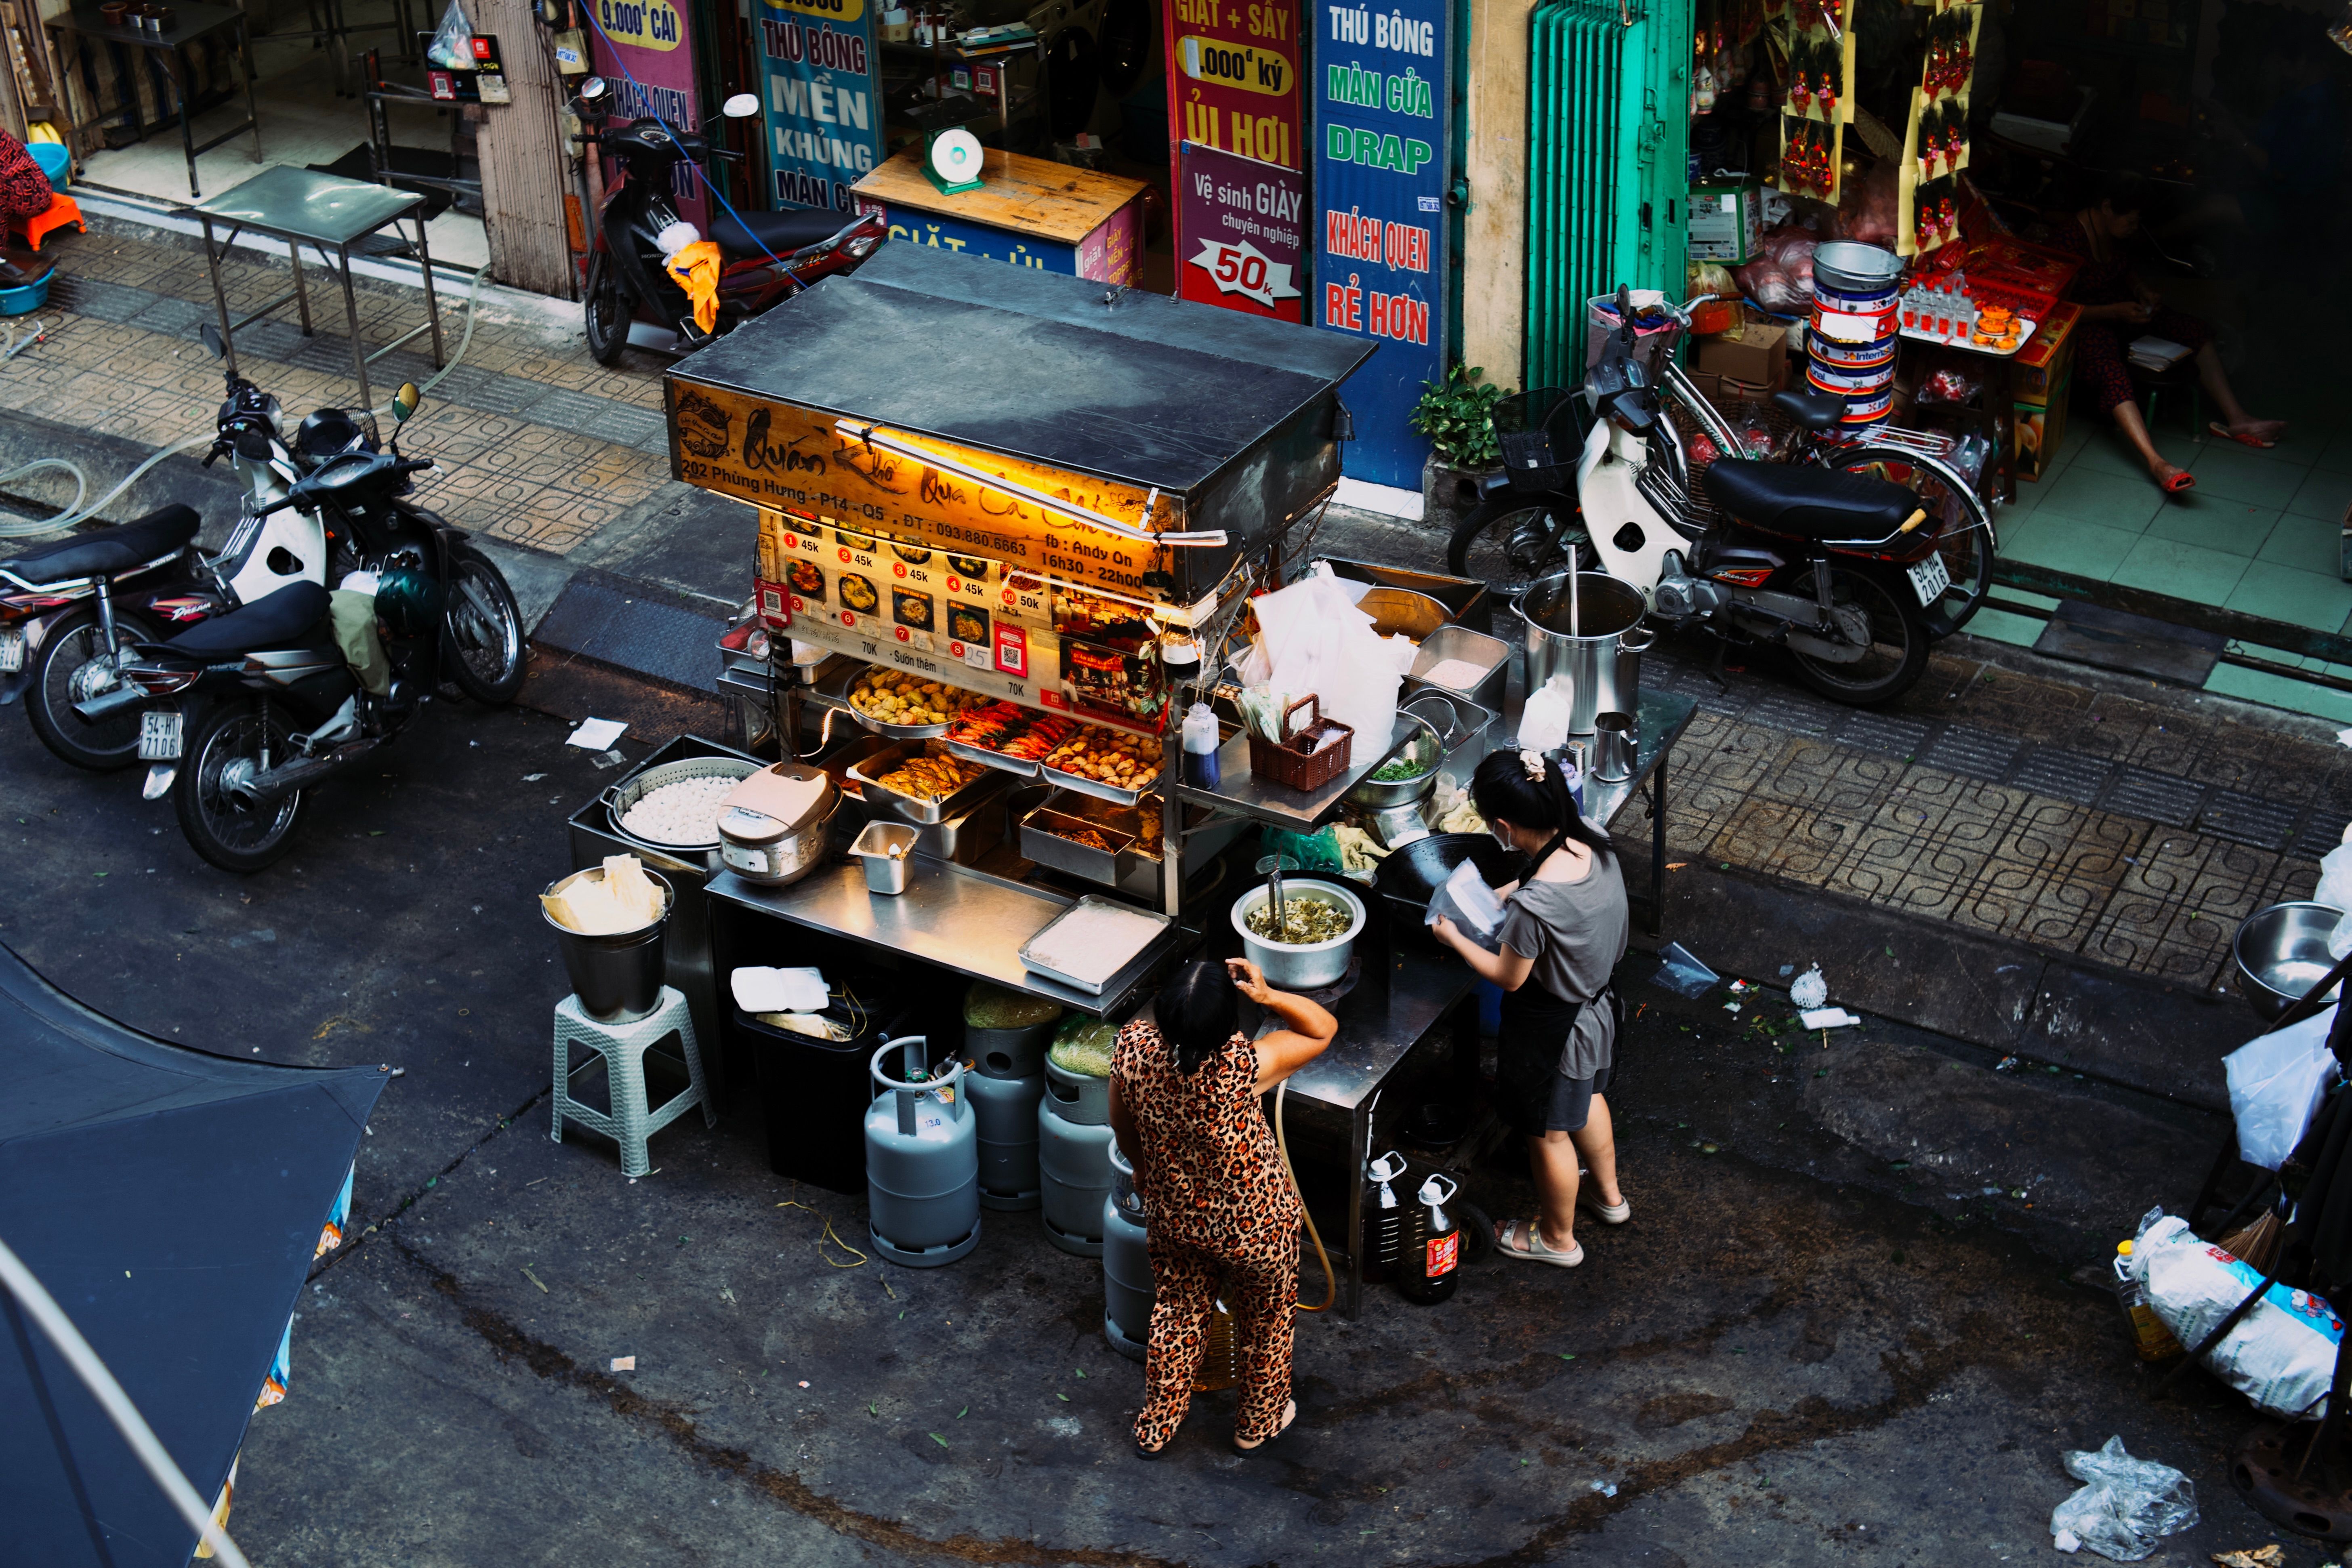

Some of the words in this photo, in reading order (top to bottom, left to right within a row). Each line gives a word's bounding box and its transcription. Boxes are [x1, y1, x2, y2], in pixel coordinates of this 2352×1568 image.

[650, 3, 677, 42] CÁI
[1329, 3, 1369, 45] THÚ
[1375, 9, 1433, 57] BÔNG
[760, 16, 804, 63] THÚ
[806, 22, 868, 76] BÔNG
[1258, 57, 1283, 92] ký
[1328, 61, 1381, 109] MÀN
[1386, 66, 1433, 119] CỬA
[770, 72, 868, 130] MỀN
[1185, 88, 1220, 149] ỦI
[1232, 111, 1290, 166] HƠI
[775, 127, 872, 173] KHỦNG
[1327, 123, 1432, 175] DRAP
[775, 167, 829, 209] MÀN
[1194, 172, 1213, 205] Vệ
[1217, 182, 1252, 211] sinh
[1256, 179, 1302, 223] GIÀY
[1222, 212, 1260, 235] chuyên
[1263, 227, 1299, 250] nghiệp
[1327, 206, 1382, 263] KHÁCH
[1385, 221, 1430, 273] QUEN
[1084, 245, 1101, 272] giặt
[1215, 246, 1273, 296] 50k
[1326, 273, 1362, 331] RẺ
[1370, 291, 1429, 346] HƠN
[681, 459, 708, 478] 202
[712, 466, 760, 493] Phùng
[764, 478, 806, 504] Hưng
[820, 492, 848, 512] P14
[862, 503, 884, 521] Q5
[904, 514, 924, 530] ĐT
[937, 523, 1026, 556] 093.880.6663
[149, 553, 177, 569] HONDA
[801, 540, 819, 553] 45k
[841, 551, 849, 559] 2
[855, 554, 872, 568] 45k
[1045, 534, 1059, 549] fb
[1073, 540, 1108, 561] Andy
[1113, 551, 1132, 567] On
[896, 566, 904, 575] 3
[910, 569, 928, 582] 45k
[1042, 552, 1084, 574] 16h30
[1098, 567, 1143, 589] 22h00
[1717, 570, 1750, 581] Dream
[1922, 569, 1946, 602] 2016
[793, 600, 800, 608] 5
[950, 580, 958, 589] 4
[965, 583, 984, 596] 45k
[1004, 592, 1014, 601] 10
[1020, 595, 1039, 610] 50k
[845, 615, 851, 623] 6
[899, 630, 905, 638] 7
[862, 641, 877, 656] 70K
[894, 649, 914, 667] Sườn
[916, 656, 937, 673] thêm
[954, 645, 961, 654] 8
[966, 646, 988, 666] 25
[1008, 681, 1024, 697] 70K
[145, 737, 176, 756] 7106
[925, 1118, 941, 1127] 13.0
